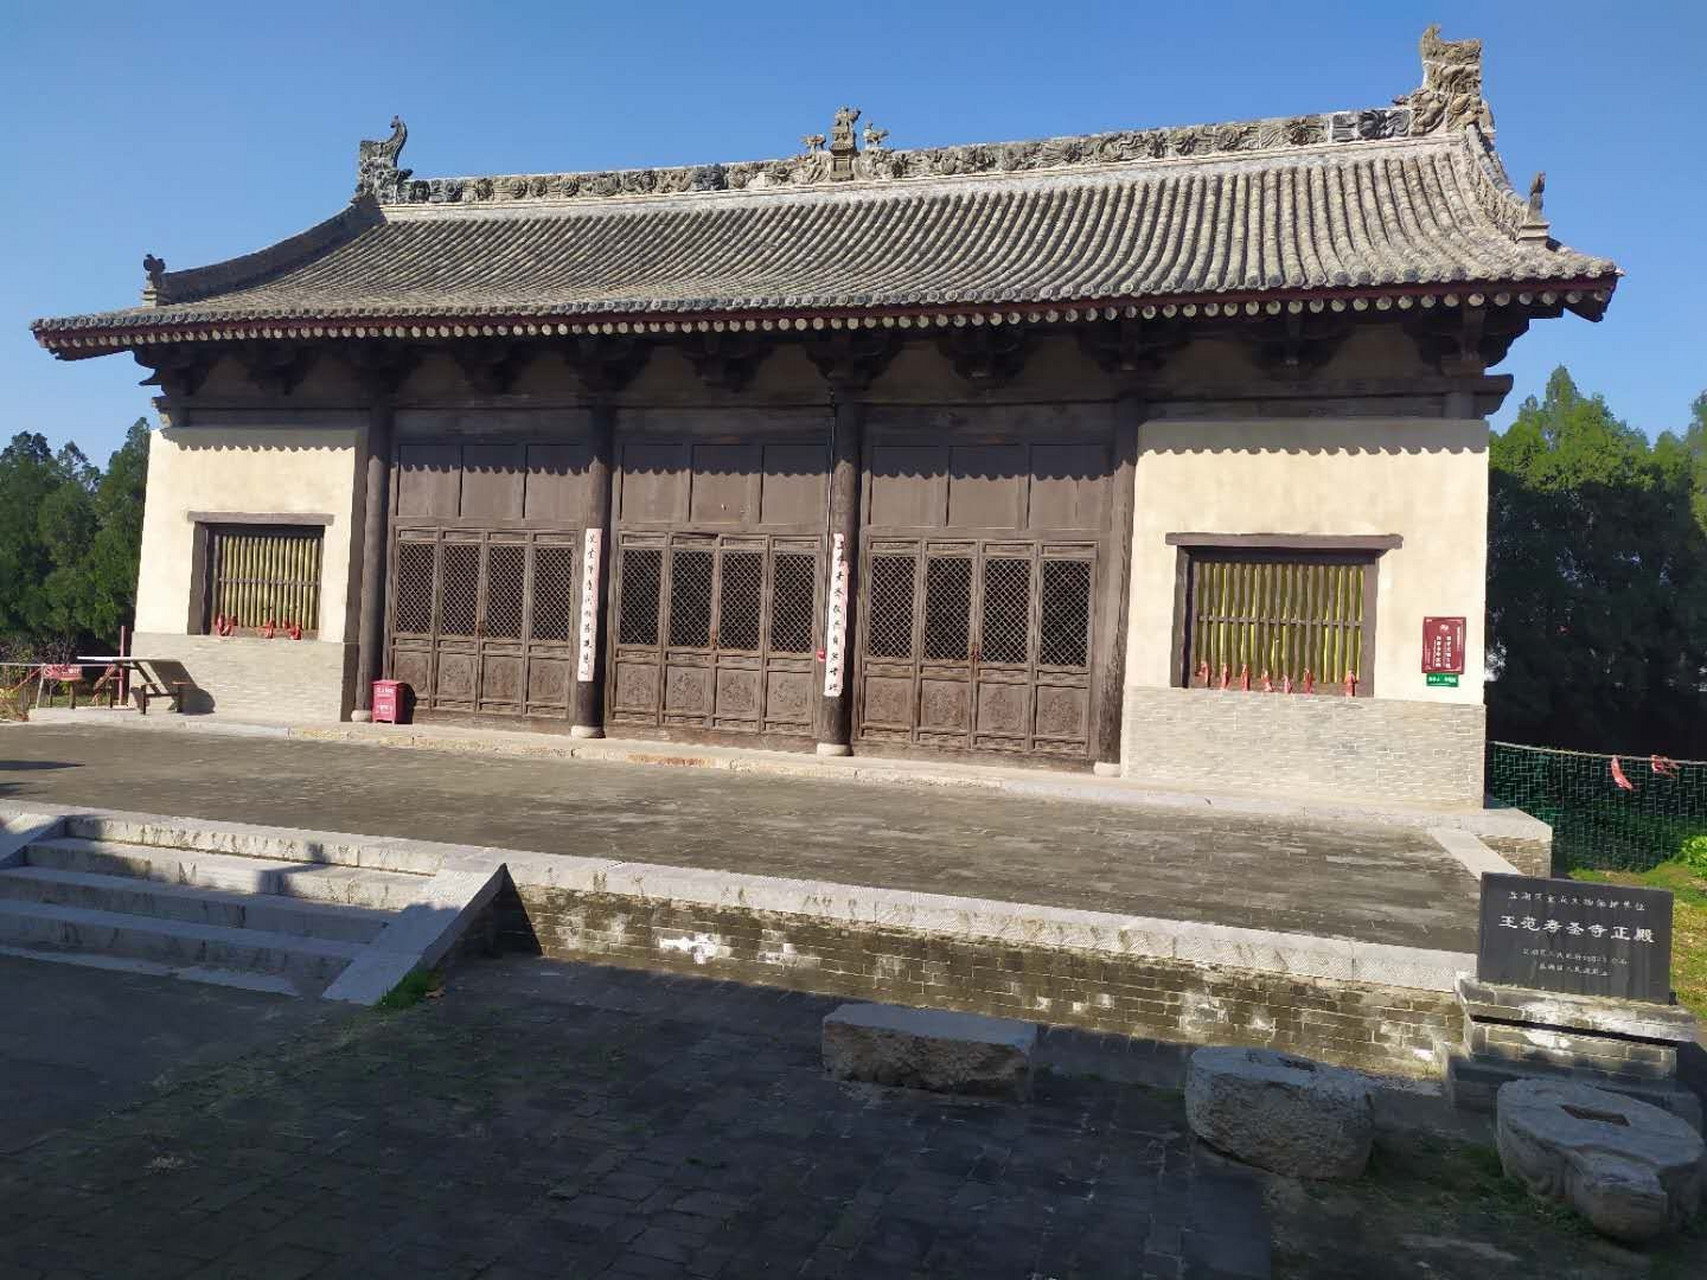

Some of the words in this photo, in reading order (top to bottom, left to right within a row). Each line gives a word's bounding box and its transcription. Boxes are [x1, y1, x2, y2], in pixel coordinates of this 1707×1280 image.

[1498, 915, 1656, 943] 王范孝圣寺正殿
